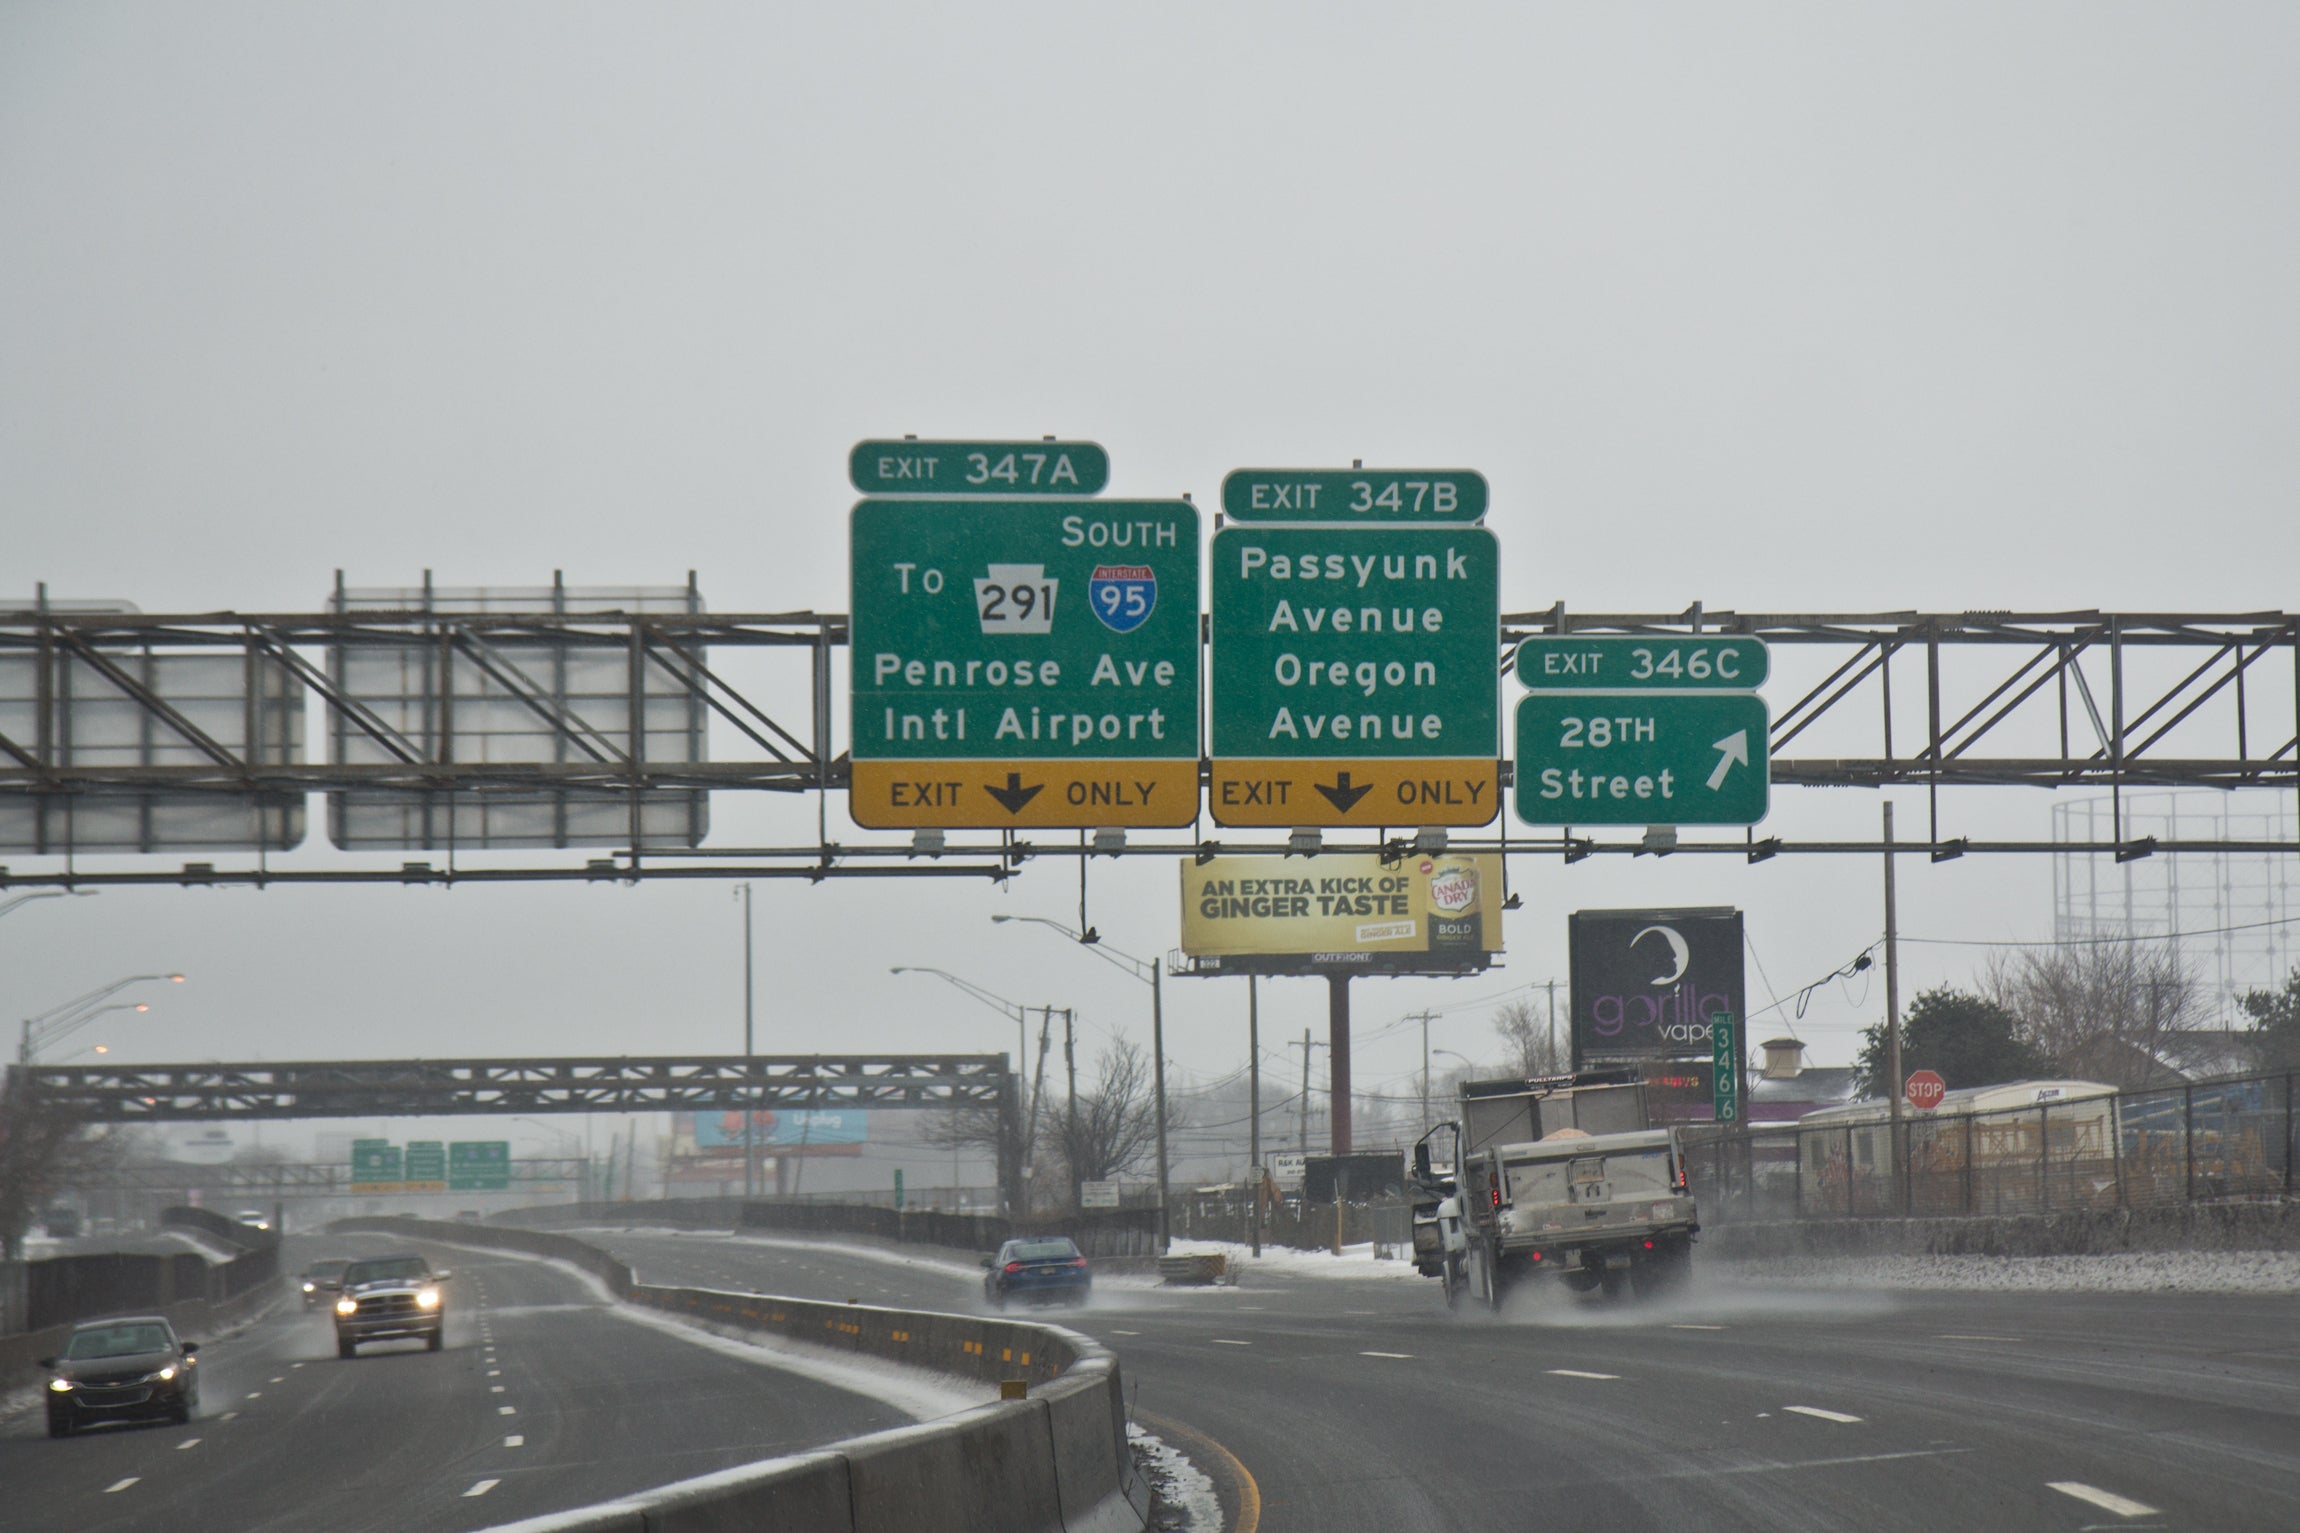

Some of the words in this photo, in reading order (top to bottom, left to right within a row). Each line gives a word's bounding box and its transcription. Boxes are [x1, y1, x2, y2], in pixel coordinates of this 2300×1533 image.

[878, 457, 939, 479] EXIT
[965, 453, 1079, 485] 347A
[1251, 484, 1322, 509] EXIT
[1349, 481, 1459, 512] 347B
[1061, 516, 1176, 547] SOUTH
[1098, 568, 1148, 579] INTERSTATE
[1241, 547, 1468, 588] Passyunk
[981, 584, 1051, 621] 291
[1100, 586, 1146, 617] 95
[1268, 599, 1443, 632] Avenue
[874, 653, 1061, 687] Penrose
[1090, 653, 1176, 687] Ave
[1274, 653, 1436, 697] Oregon
[1544, 652, 1603, 674] EXIT
[1630, 648, 1741, 680] 346C
[885, 707, 966, 740] Intl
[994, 707, 1166, 746] Airport
[1268, 707, 1442, 740] Avenue
[1559, 716, 1656, 748] 28TH
[891, 782, 963, 807] EXIT
[1066, 781, 1157, 806] ONLY
[1222, 780, 1293, 806] EXIT
[1396, 780, 1487, 805] ONLY
[1539, 768, 1675, 800] Street
[1201, 880, 1235, 897] AN
[1240, 878, 1315, 896] EXTRA
[1320, 877, 1374, 895] KICK
[1378, 876, 1410, 893] OF
[1443, 891, 1469, 906] DRY
[1199, 896, 1310, 920] GINGER
[1316, 894, 1410, 917] TASTE
[1438, 924, 1472, 934] BOLD
[1591, 983, 1730, 1036] gorilla
[1713, 1015, 1733, 1024] MILE
[1908, 1081, 1943, 1098] STOP
